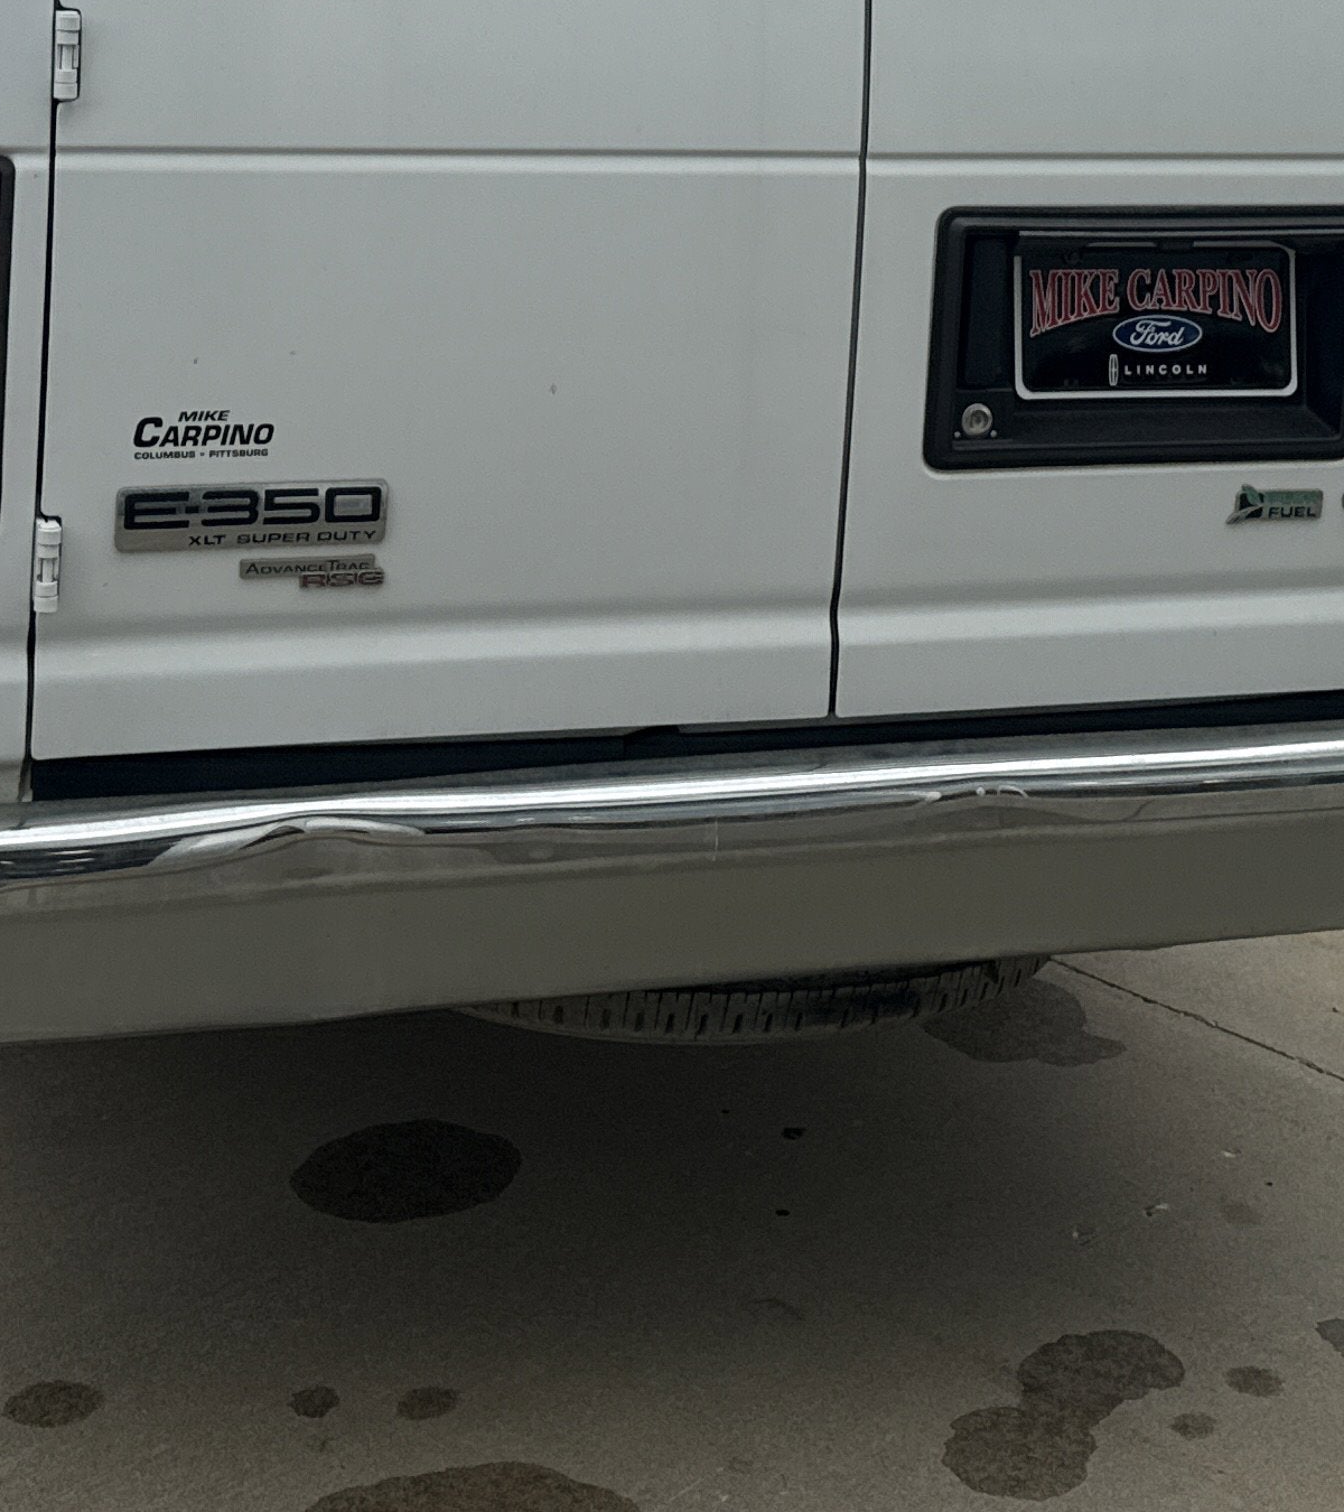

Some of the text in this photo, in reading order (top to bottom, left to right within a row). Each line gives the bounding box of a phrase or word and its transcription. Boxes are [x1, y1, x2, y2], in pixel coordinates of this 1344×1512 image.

[1029, 269, 1283, 337] MIKE CARPINO
[1130, 320, 1185, 346] Ford
[1124, 364, 1208, 375] LINCOLN
[178, 409, 231, 422] MIKE
[132, 416, 275, 448] CARPINO
[134, 448, 269, 460] COLUMBUS PITTSBURG
[123, 486, 382, 531] E-350
[1268, 506, 1317, 518] FUEL
[188, 529, 377, 545] XLT SUPER DUTY
